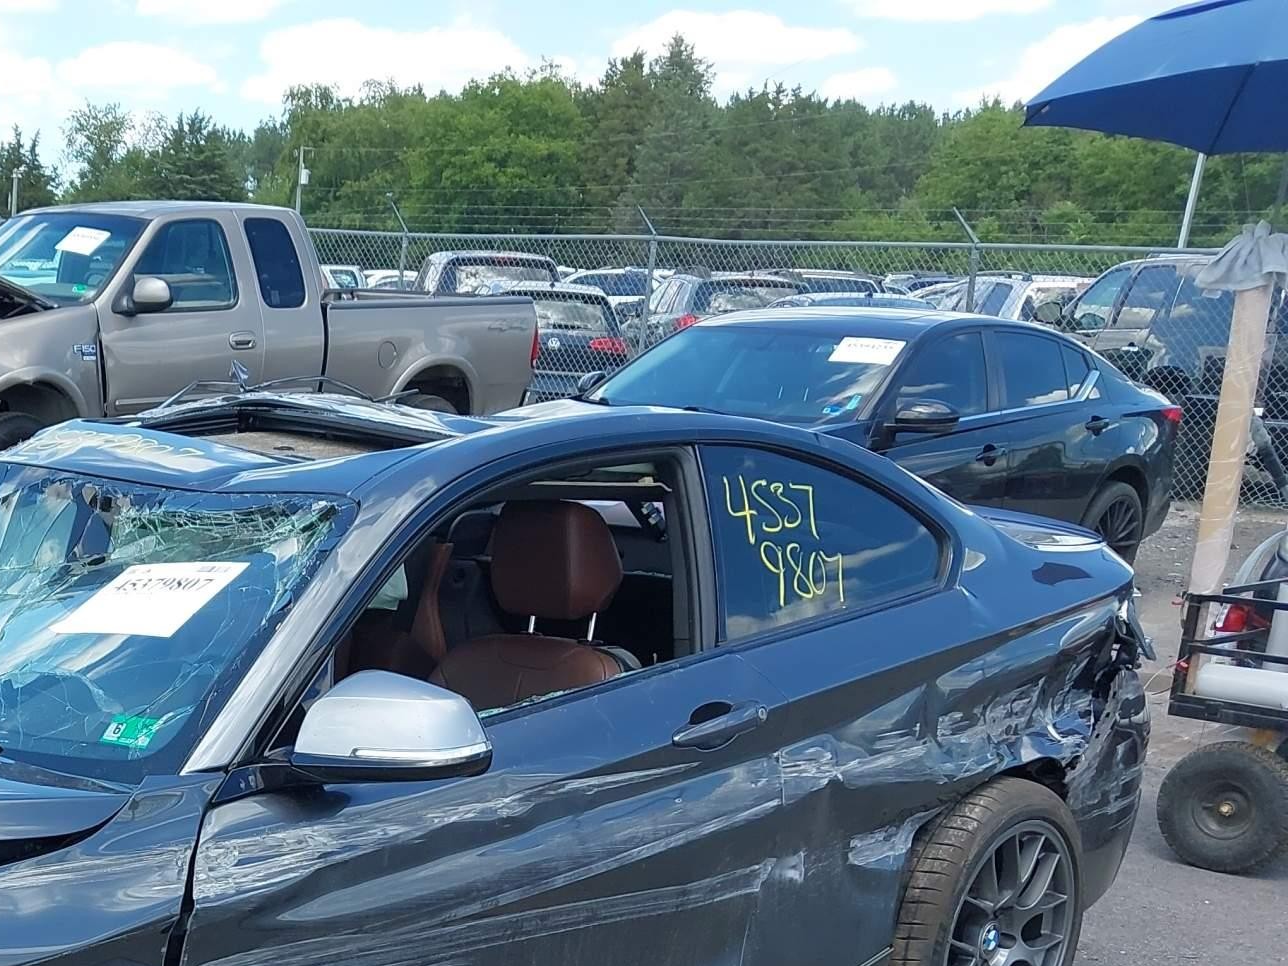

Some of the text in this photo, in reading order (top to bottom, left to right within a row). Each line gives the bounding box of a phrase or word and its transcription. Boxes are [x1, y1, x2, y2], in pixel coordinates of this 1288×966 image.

[722, 475, 820, 545] 4537
[760, 541, 845, 607] 9807
[113, 722, 124, 735] 6
